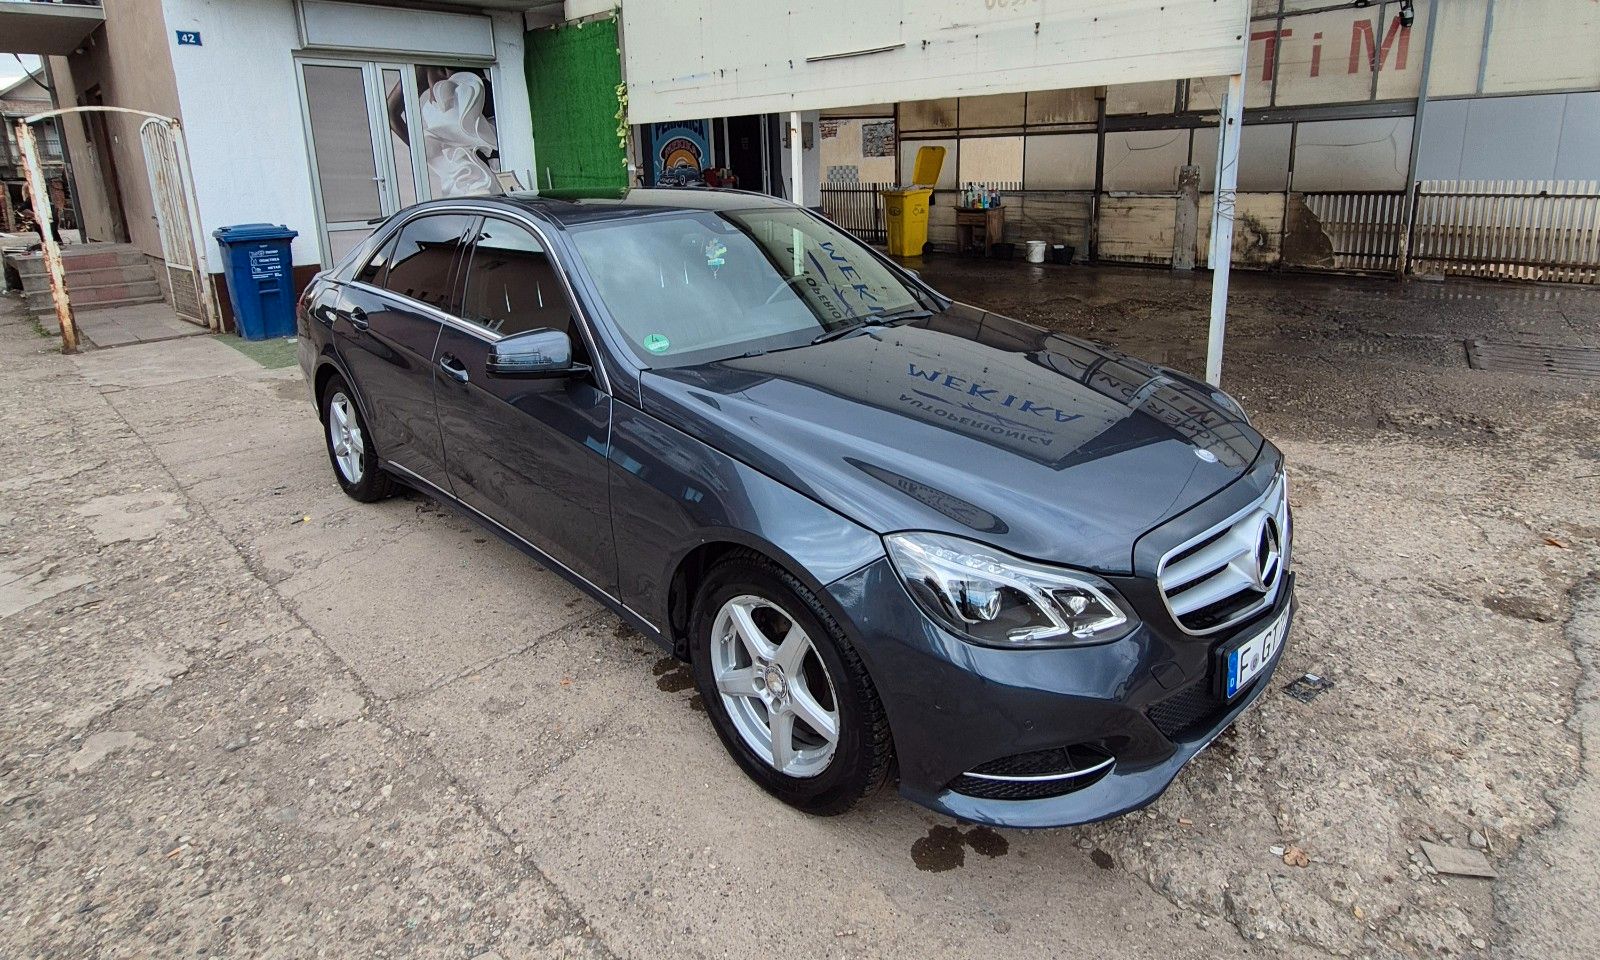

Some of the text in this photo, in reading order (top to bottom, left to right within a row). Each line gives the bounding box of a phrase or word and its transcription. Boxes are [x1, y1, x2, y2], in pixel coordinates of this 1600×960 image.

[181, 33, 196, 43] 42
[1239, 645, 1252, 683] F
[1229, 677, 1235, 688] D
